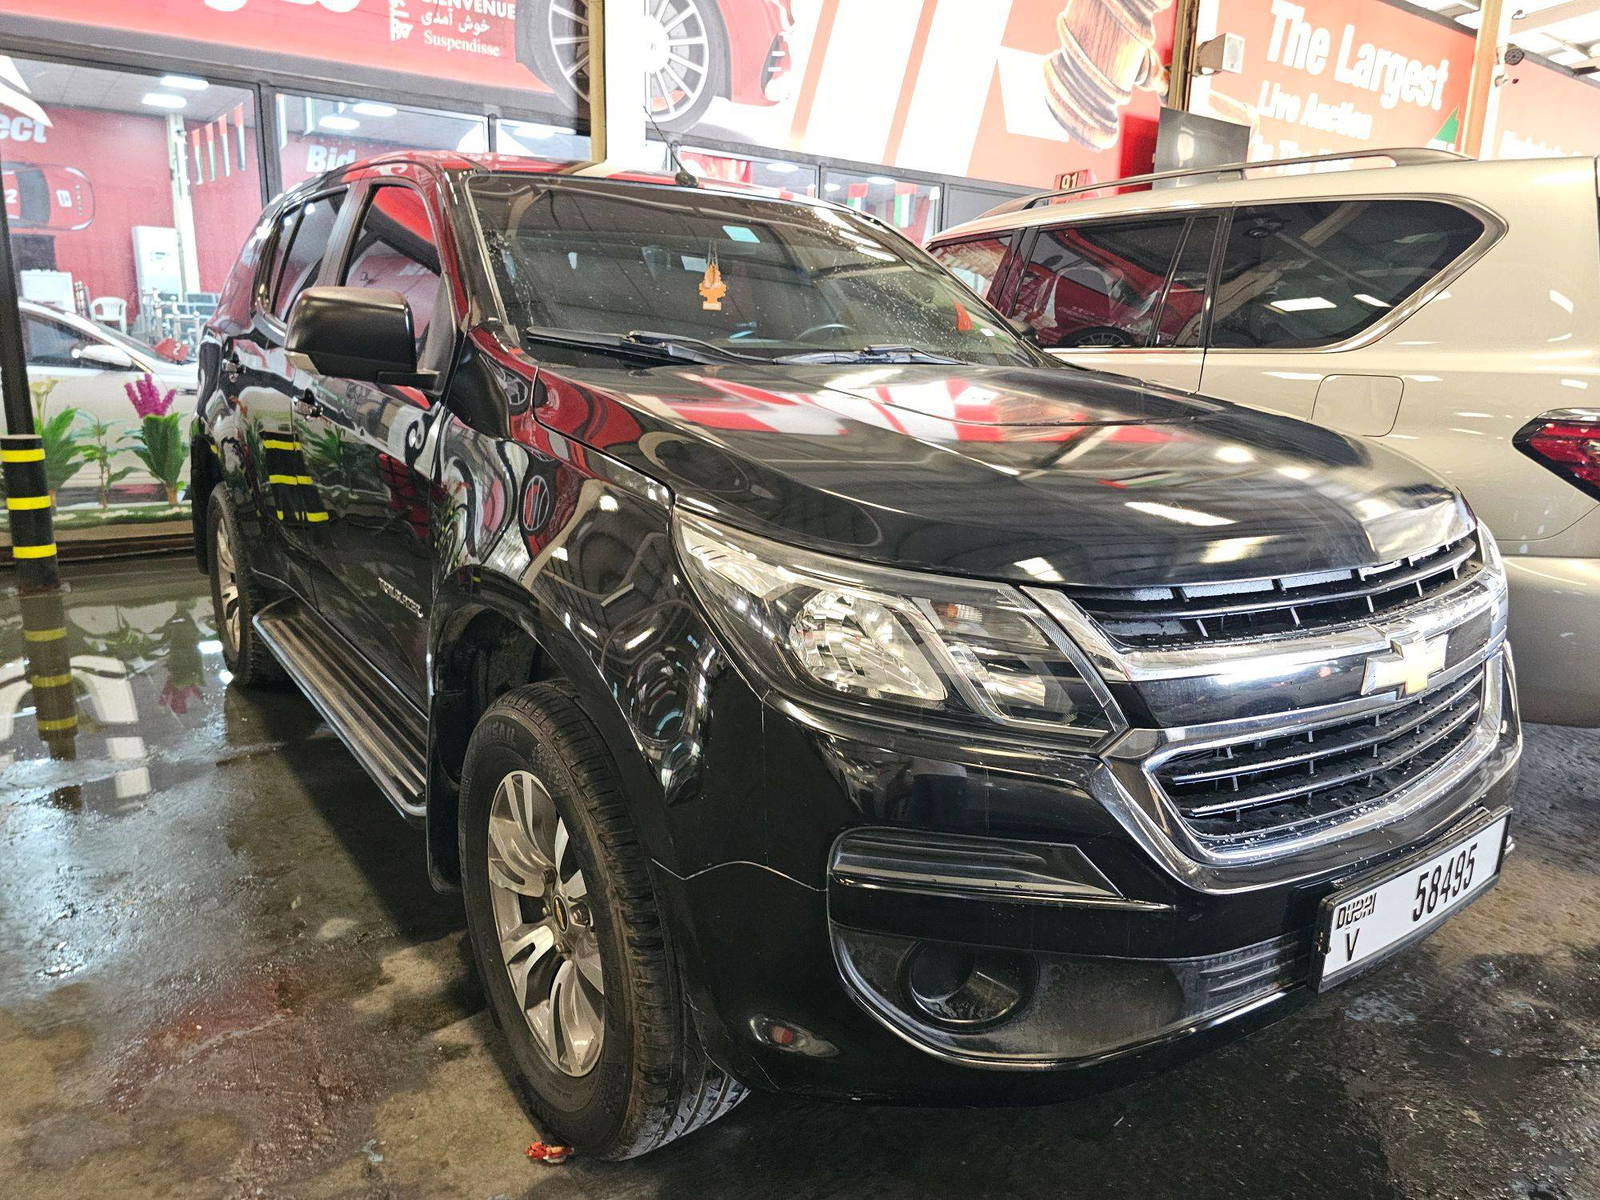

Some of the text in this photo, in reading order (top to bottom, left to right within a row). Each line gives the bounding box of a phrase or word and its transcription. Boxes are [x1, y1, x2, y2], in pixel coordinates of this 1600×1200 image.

[420, 0, 516, 20] NVENUE
[423, 29, 500, 57] Suspendisse
[1266, 0, 1450, 111] The Largest
[1258, 80, 1301, 123] Live
[306, 144, 356, 173] Bid
[1412, 842, 1478, 922] 58495
[1345, 927, 1361, 962] V
